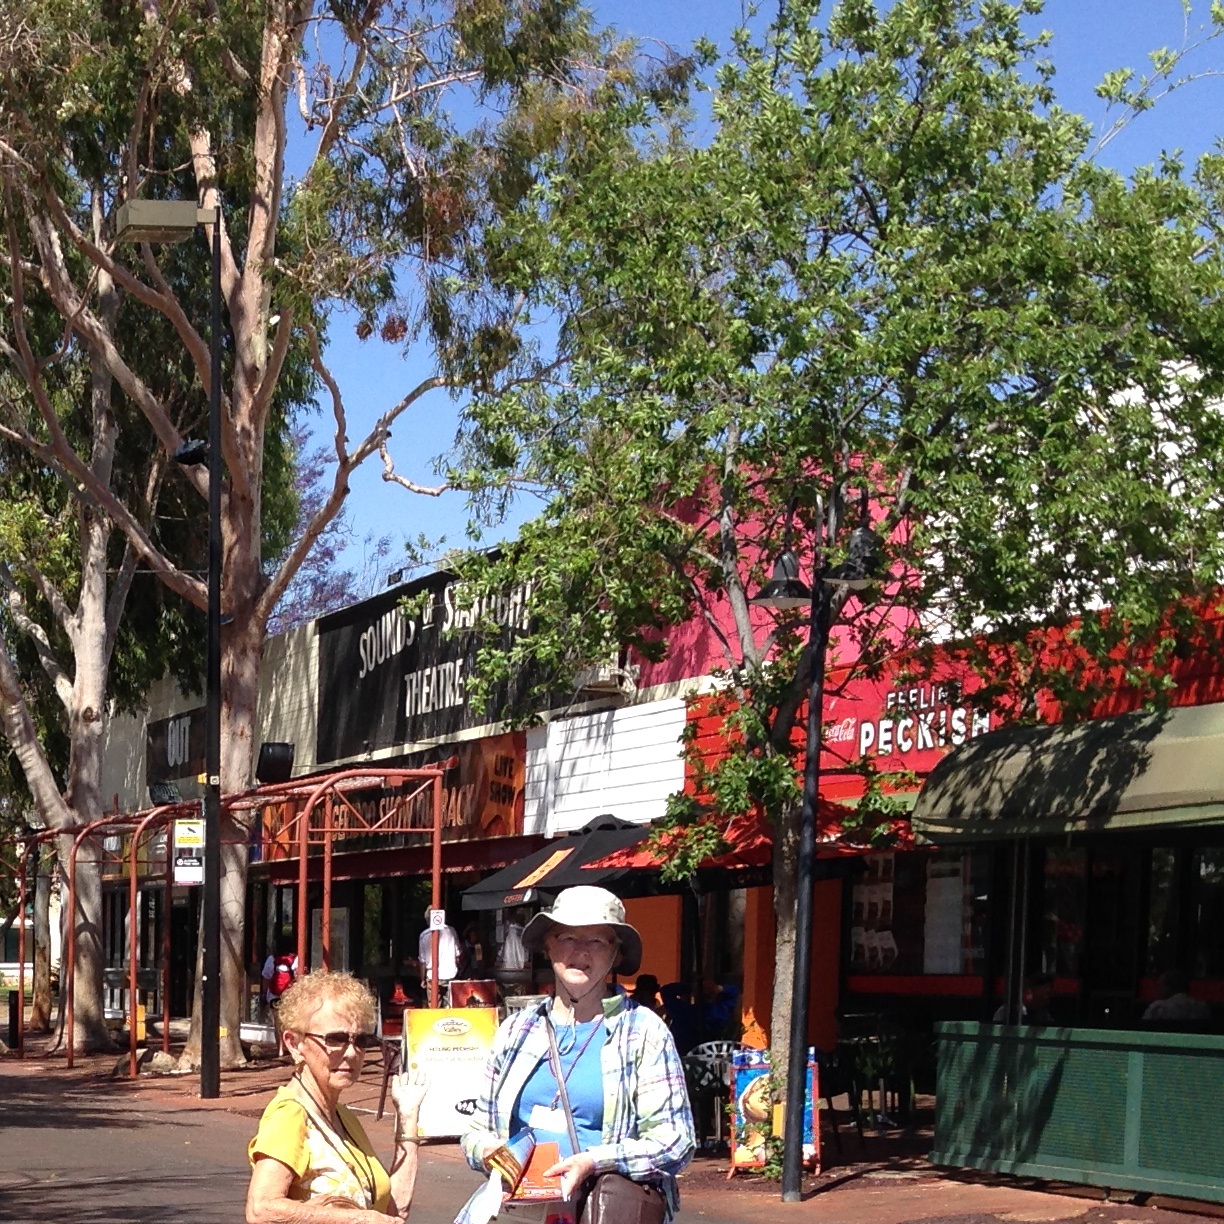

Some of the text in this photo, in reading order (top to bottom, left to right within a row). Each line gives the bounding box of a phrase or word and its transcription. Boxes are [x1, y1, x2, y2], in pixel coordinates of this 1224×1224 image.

[358, 604, 417, 679] SOUNDS
[404, 657, 465, 718] THEATRE
[859, 707, 991, 757] PECKISH
